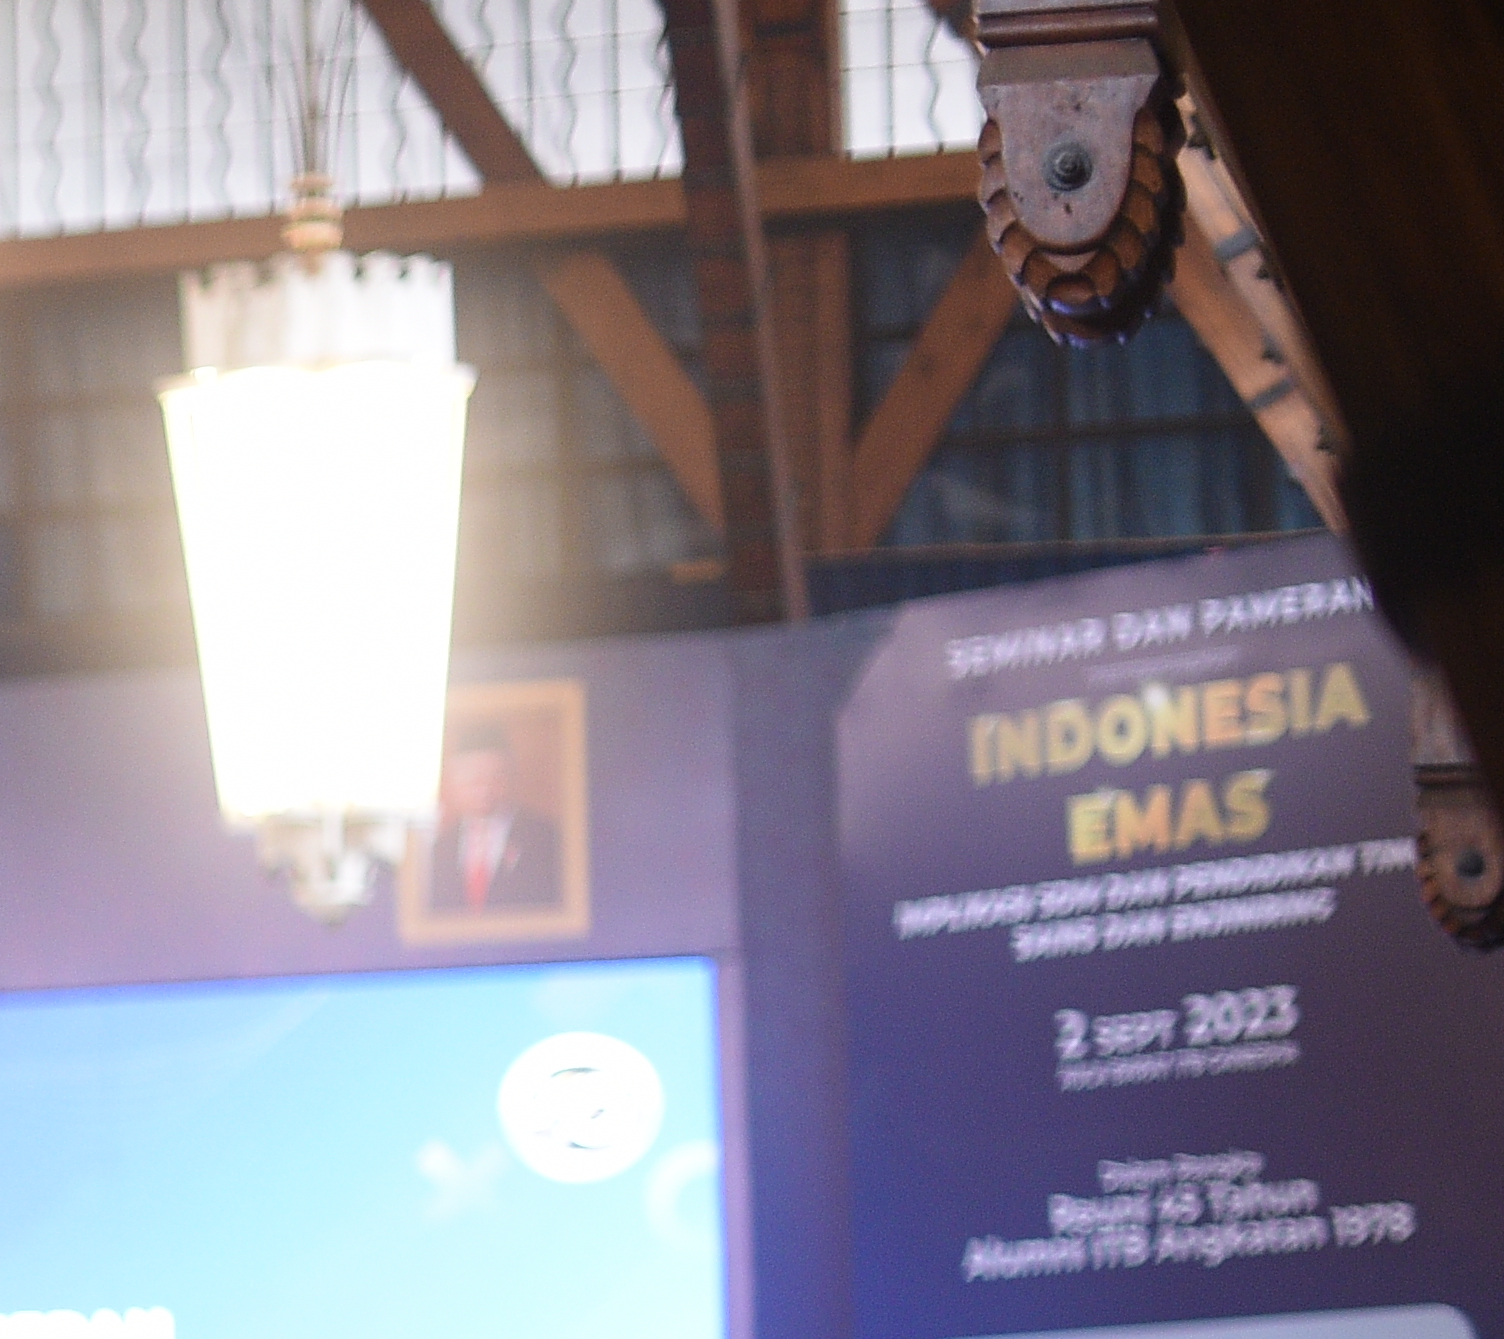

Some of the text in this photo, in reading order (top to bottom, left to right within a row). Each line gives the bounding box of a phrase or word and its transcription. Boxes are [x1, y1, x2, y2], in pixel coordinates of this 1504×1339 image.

[968, 661, 1371, 787] INDONESIA
[1065, 768, 1275, 866] EMAS
[1054, 1008, 1087, 1061] 2
[1182, 984, 1302, 1047] 2023
